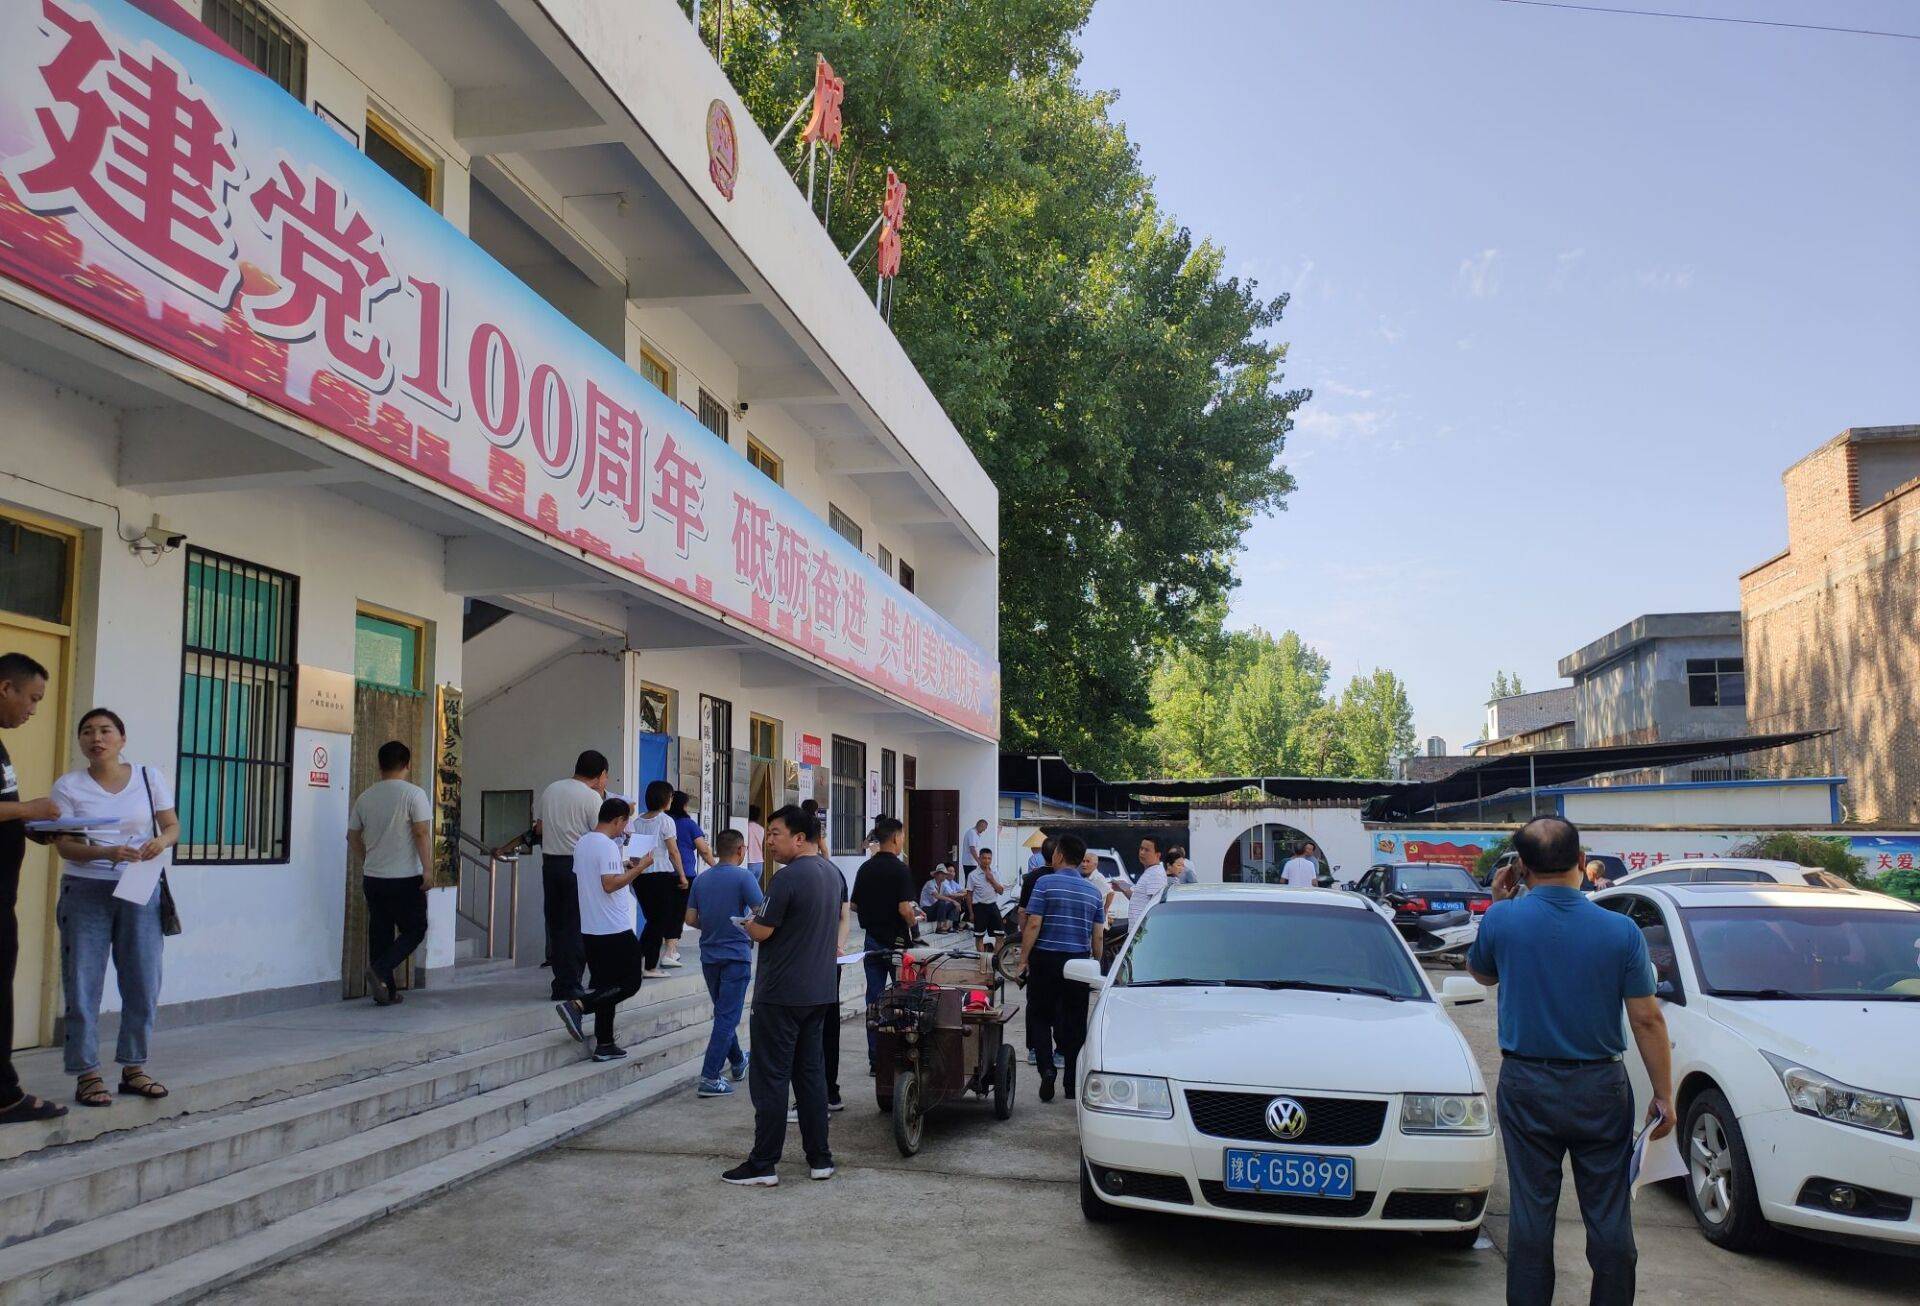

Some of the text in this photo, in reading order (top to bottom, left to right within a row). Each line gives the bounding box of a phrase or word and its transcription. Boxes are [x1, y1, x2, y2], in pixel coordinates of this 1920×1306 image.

[18, 0, 706, 553] 建党100周年
[732, 491, 868, 652] 砥砺奋进
[1876, 852, 1920, 870] 关爱
